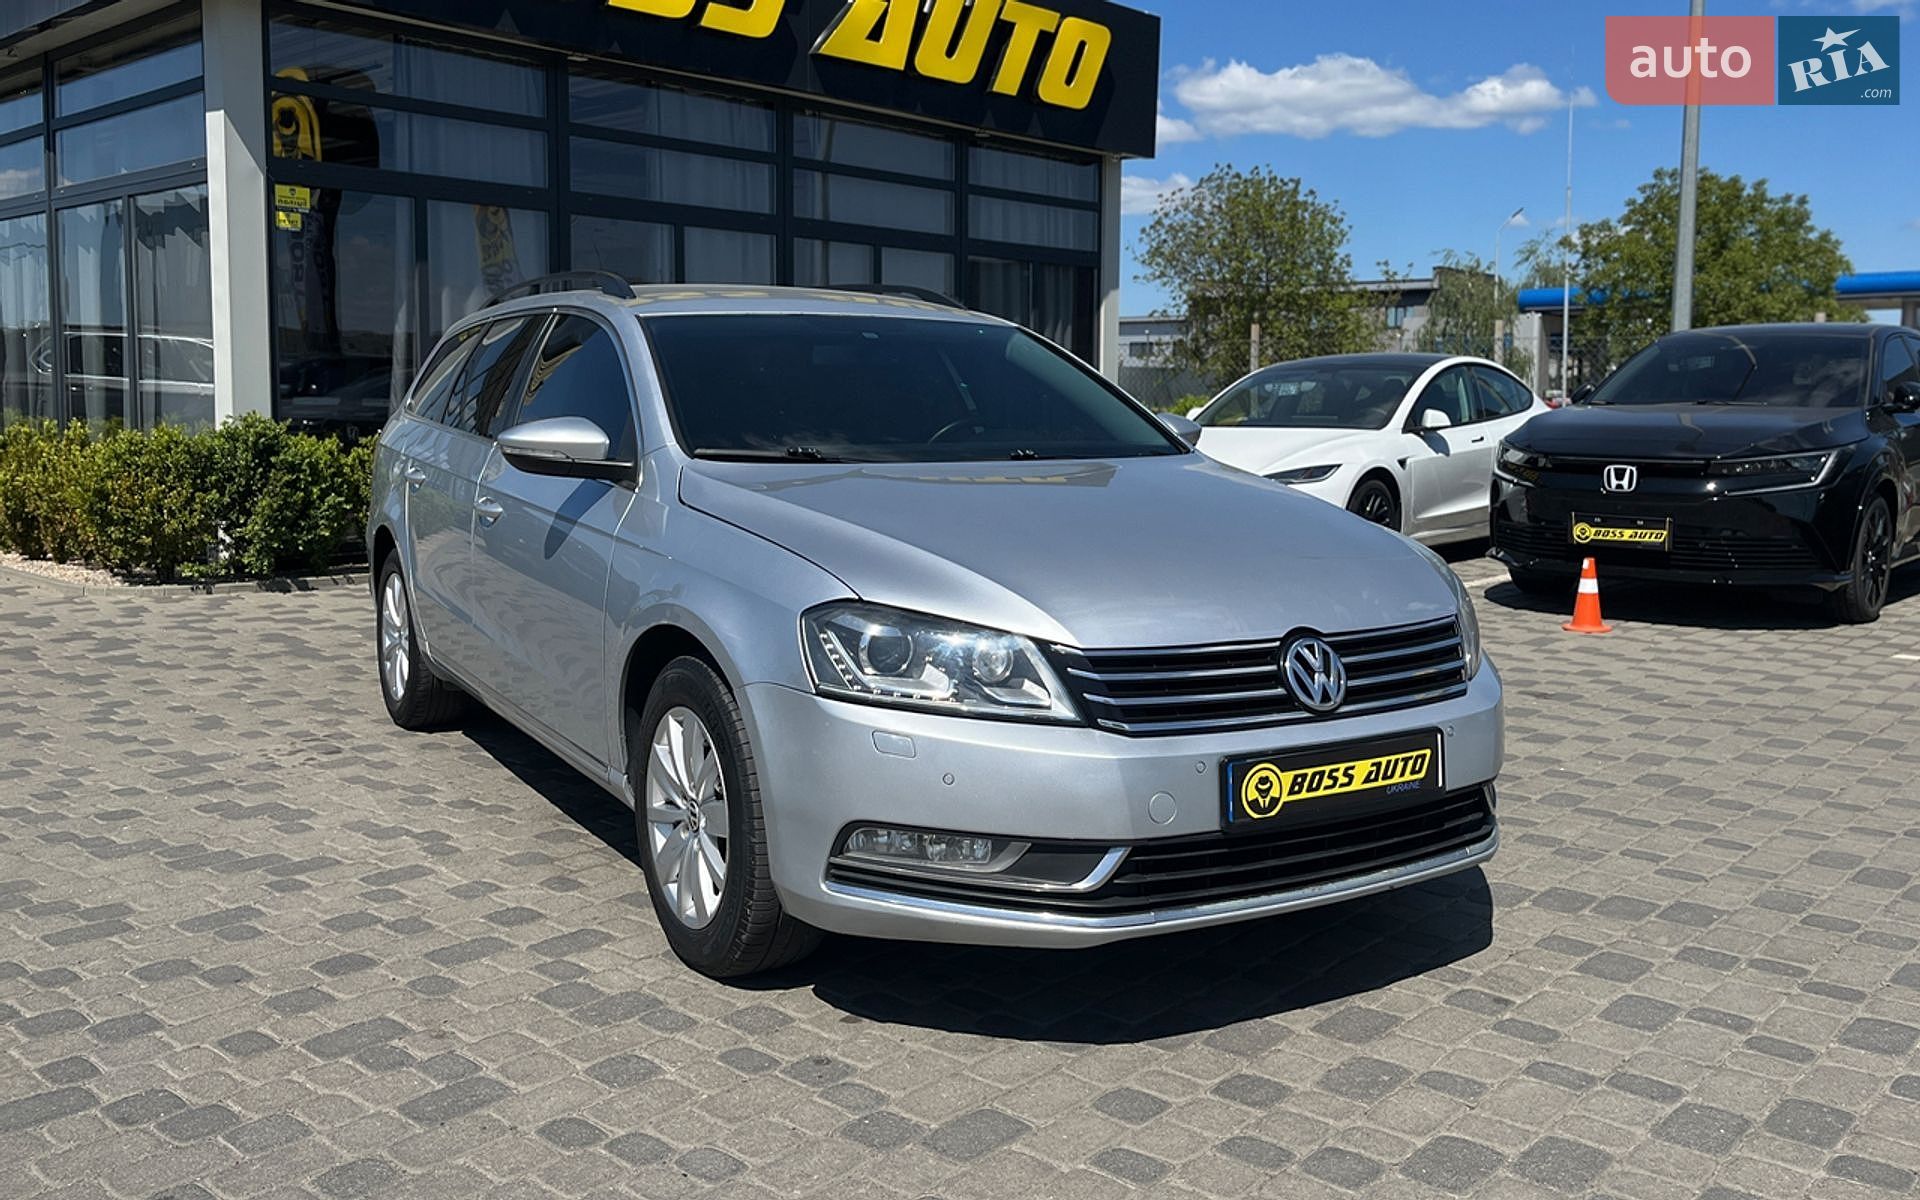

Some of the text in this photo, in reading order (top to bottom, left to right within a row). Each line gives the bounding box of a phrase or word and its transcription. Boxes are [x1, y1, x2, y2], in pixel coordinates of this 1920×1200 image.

[814, 0, 1112, 109] AUTO
[1593, 529, 1664, 540] BOSS AUTO
[1287, 752, 1428, 796] BOSS AUTO
